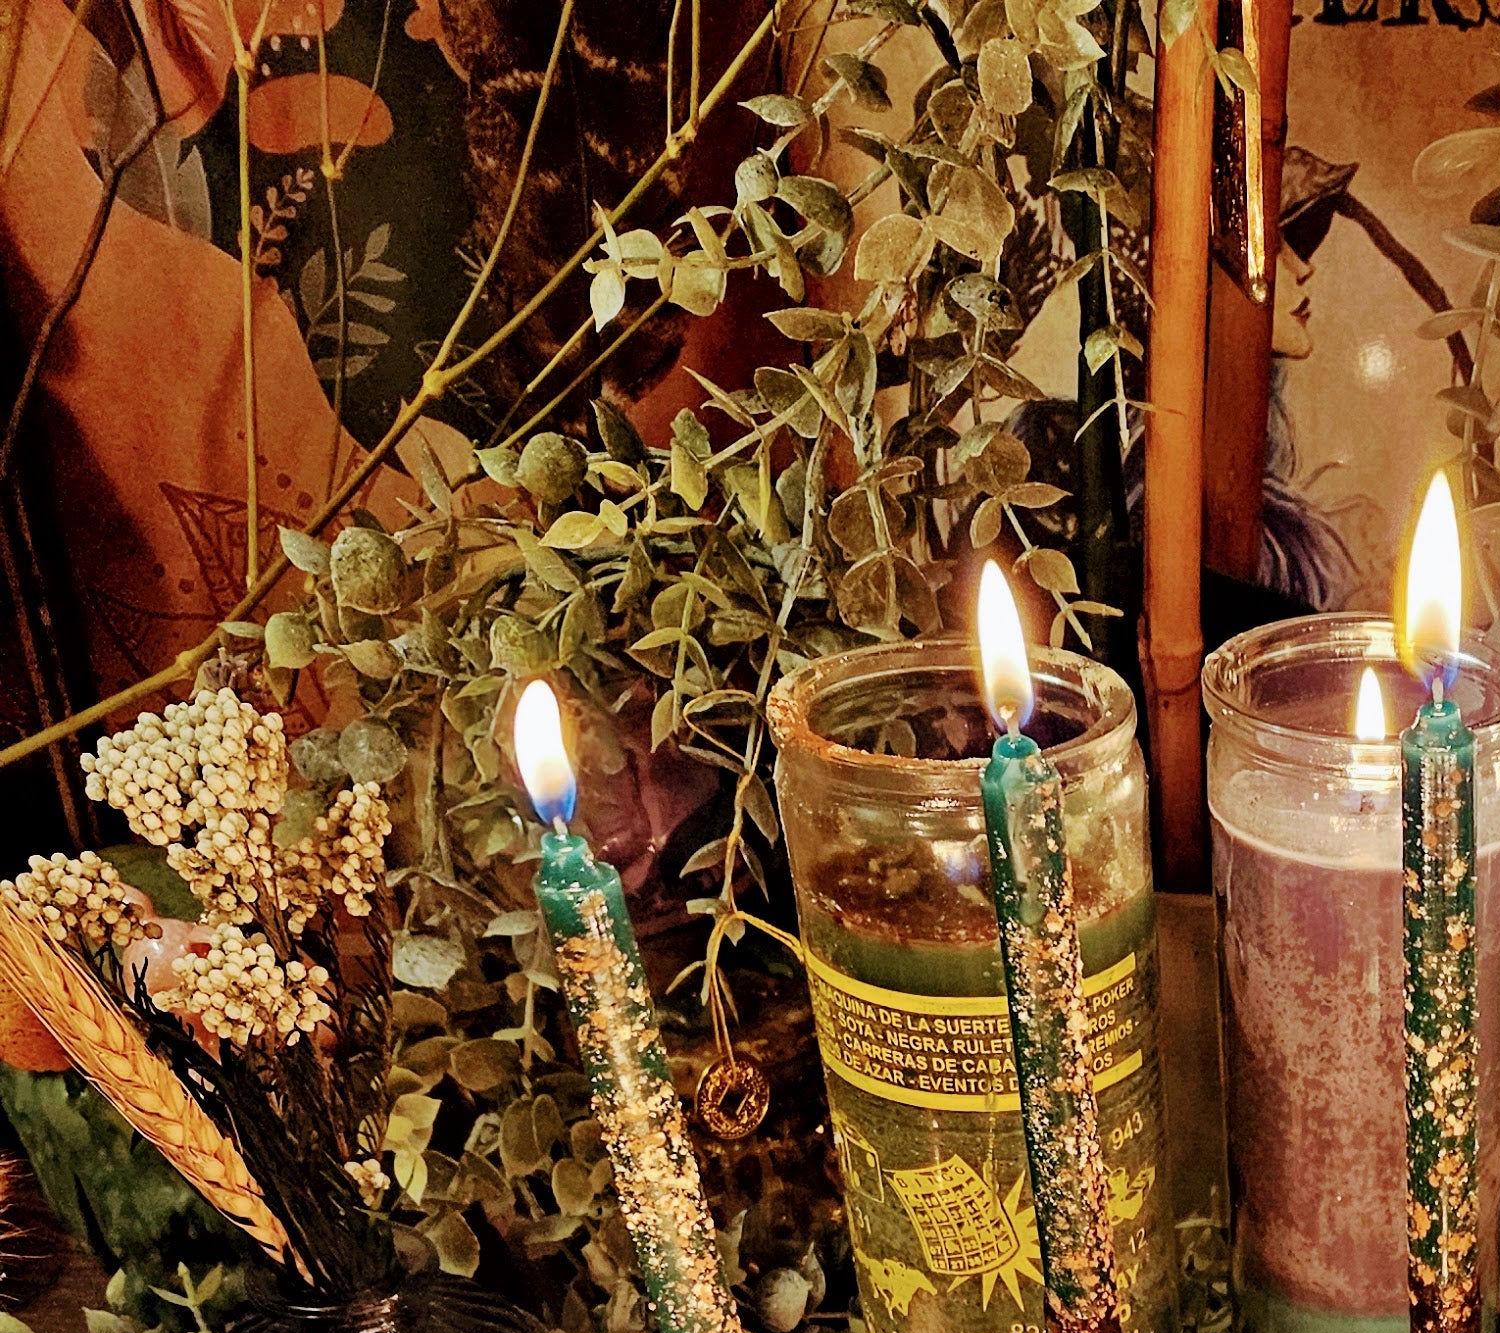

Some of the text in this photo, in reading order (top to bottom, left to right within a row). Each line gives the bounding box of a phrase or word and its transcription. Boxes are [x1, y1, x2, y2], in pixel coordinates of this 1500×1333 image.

[1092, 977, 1134, 1013] POKER
[838, 1011, 876, 1040] SOTA
[886, 1030, 950, 1054] NEGRA
[953, 1038, 1014, 1055] RULET
[879, 1009, 903, 1029] DE
[907, 1016, 931, 1034] LA
[934, 1018, 1010, 1036] SUERTE
[1088, 1019, 1133, 1054] REMIOS
[843, 1033, 928, 1071] CARRERAS
[932, 1058, 958, 1074] DE
[962, 1059, 1016, 1075] CABA
[844, 1050, 863, 1072] DE
[864, 1063, 906, 1087] AZAR
[919, 1074, 1004, 1094] EVENTOS
[1111, 1111, 1143, 1150] 943
[1129, 1227, 1147, 1254] 12
